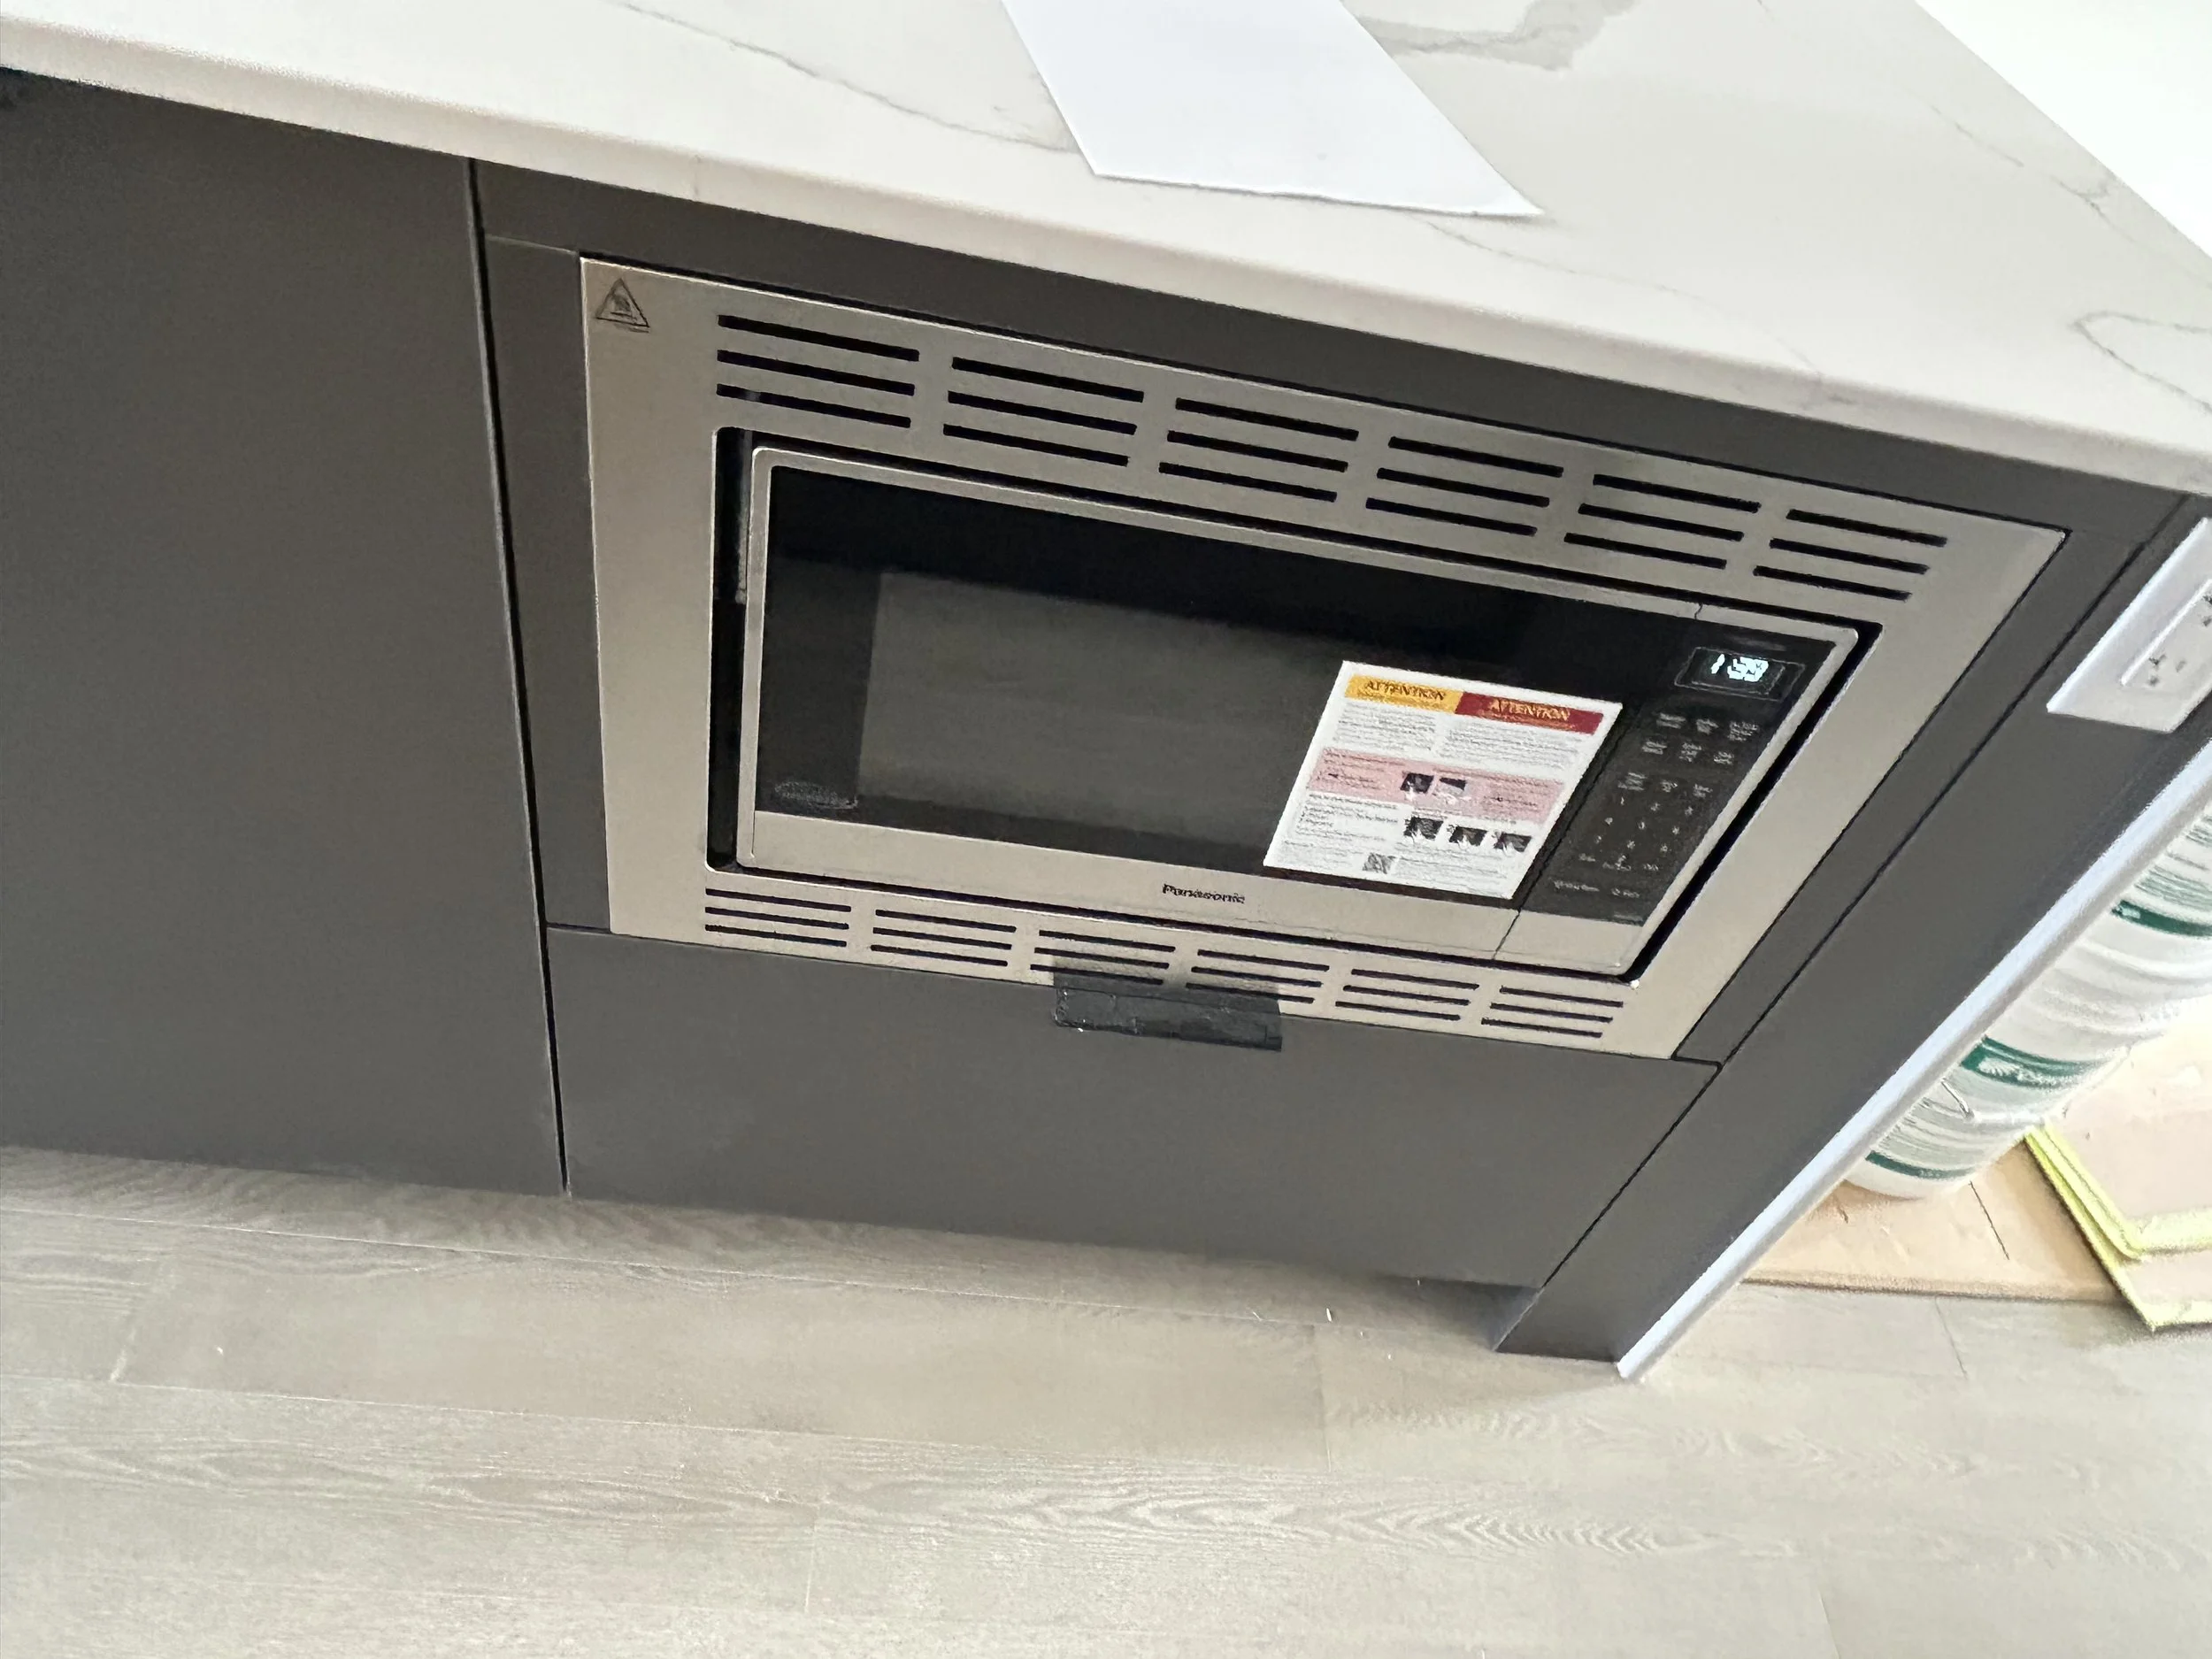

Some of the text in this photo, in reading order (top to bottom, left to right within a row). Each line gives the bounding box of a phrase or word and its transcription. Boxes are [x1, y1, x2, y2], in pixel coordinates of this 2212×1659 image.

[1363, 680, 1447, 702] ATTENTION
[1489, 696, 1571, 721] ATTENTION
[1162, 883, 1245, 903] Panasonic
